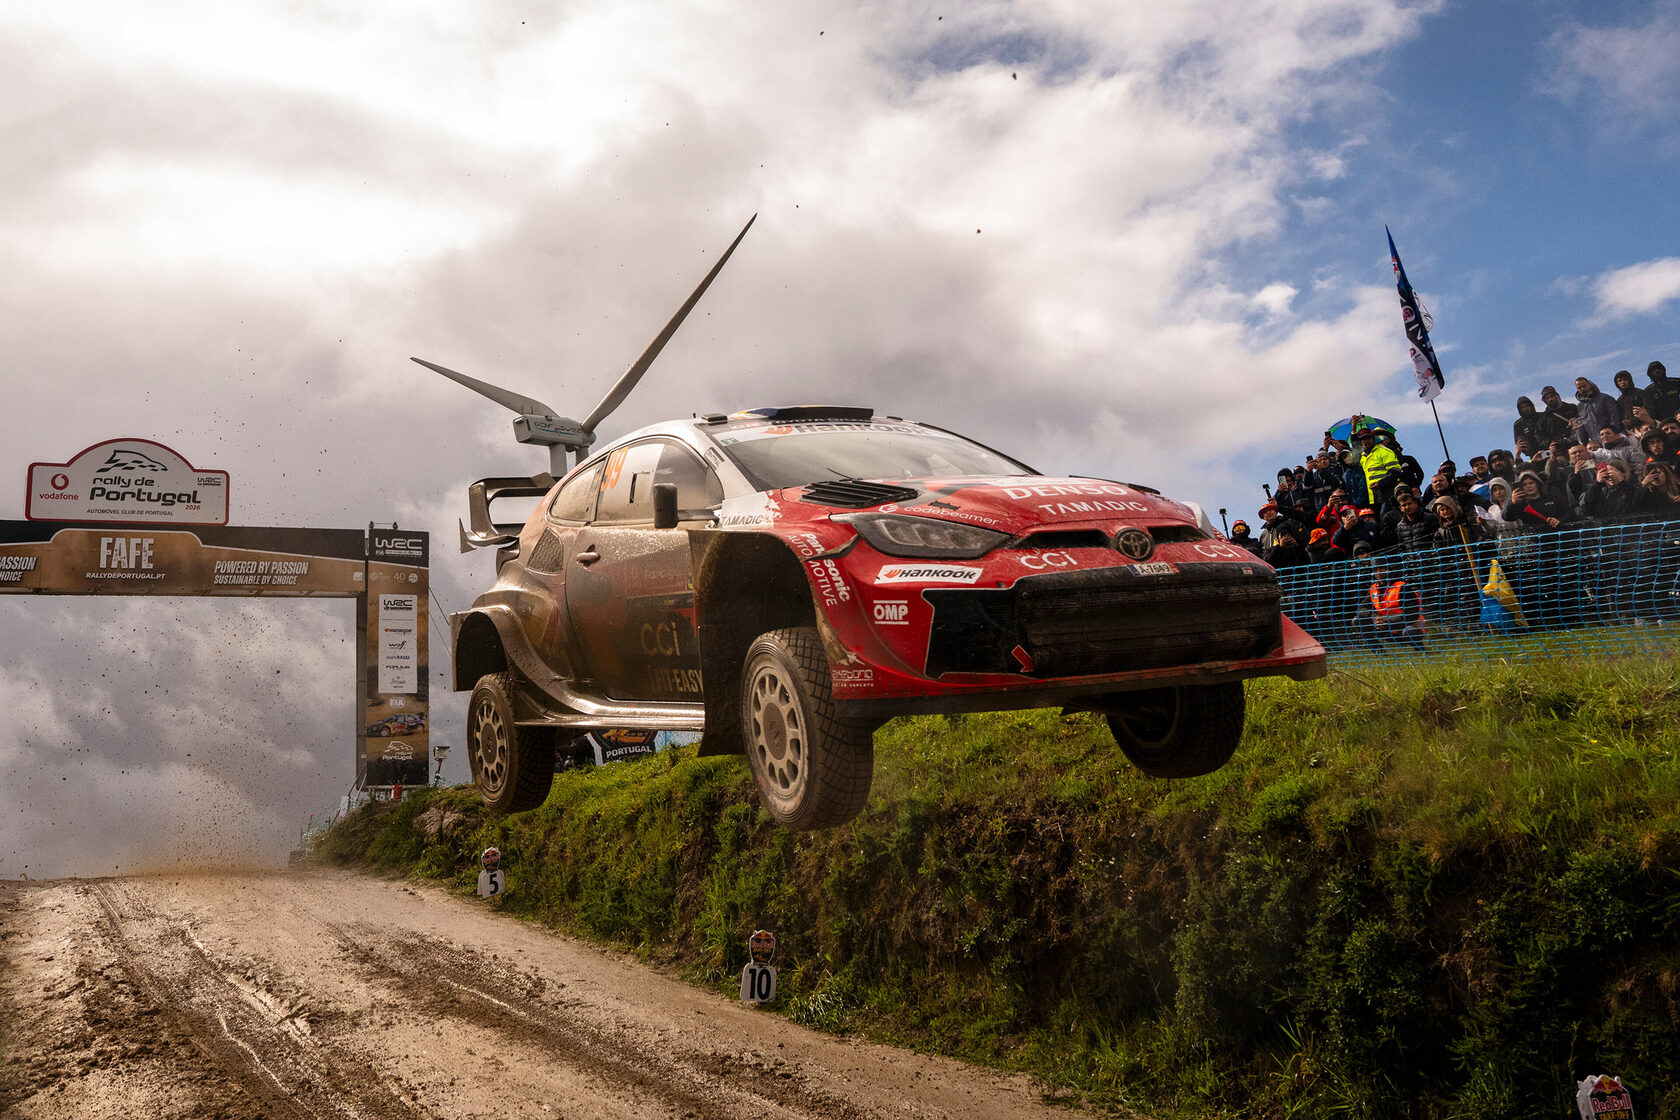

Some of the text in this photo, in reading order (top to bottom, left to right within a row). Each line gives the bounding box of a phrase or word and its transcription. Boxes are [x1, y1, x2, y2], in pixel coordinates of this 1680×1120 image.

[92, 476, 155, 487] rally de
[39, 492, 79, 501] vodafone
[89, 486, 201, 507] Portugal
[1000, 484, 1129, 500] DENSO
[1038, 500, 1148, 516] TAMADIC
[720, 515, 764, 526] TAMADIC
[904, 506, 1001, 526] codebeamer
[375, 537, 422, 549] WRC
[100, 537, 154, 569] FAFE
[0, 556, 37, 570] ASSION
[214, 560, 309, 575] POWERED BY PASSION
[800, 533, 850, 602] Pansonic
[0, 571, 22, 581] HOICE
[213, 575, 298, 585] SUSTAINABLE BY CHOICE
[873, 604, 908, 620] OMP
[606, 745, 652, 759] PORTUGAL
[489, 873, 499, 895] 5
[749, 968, 771, 1000] 10
